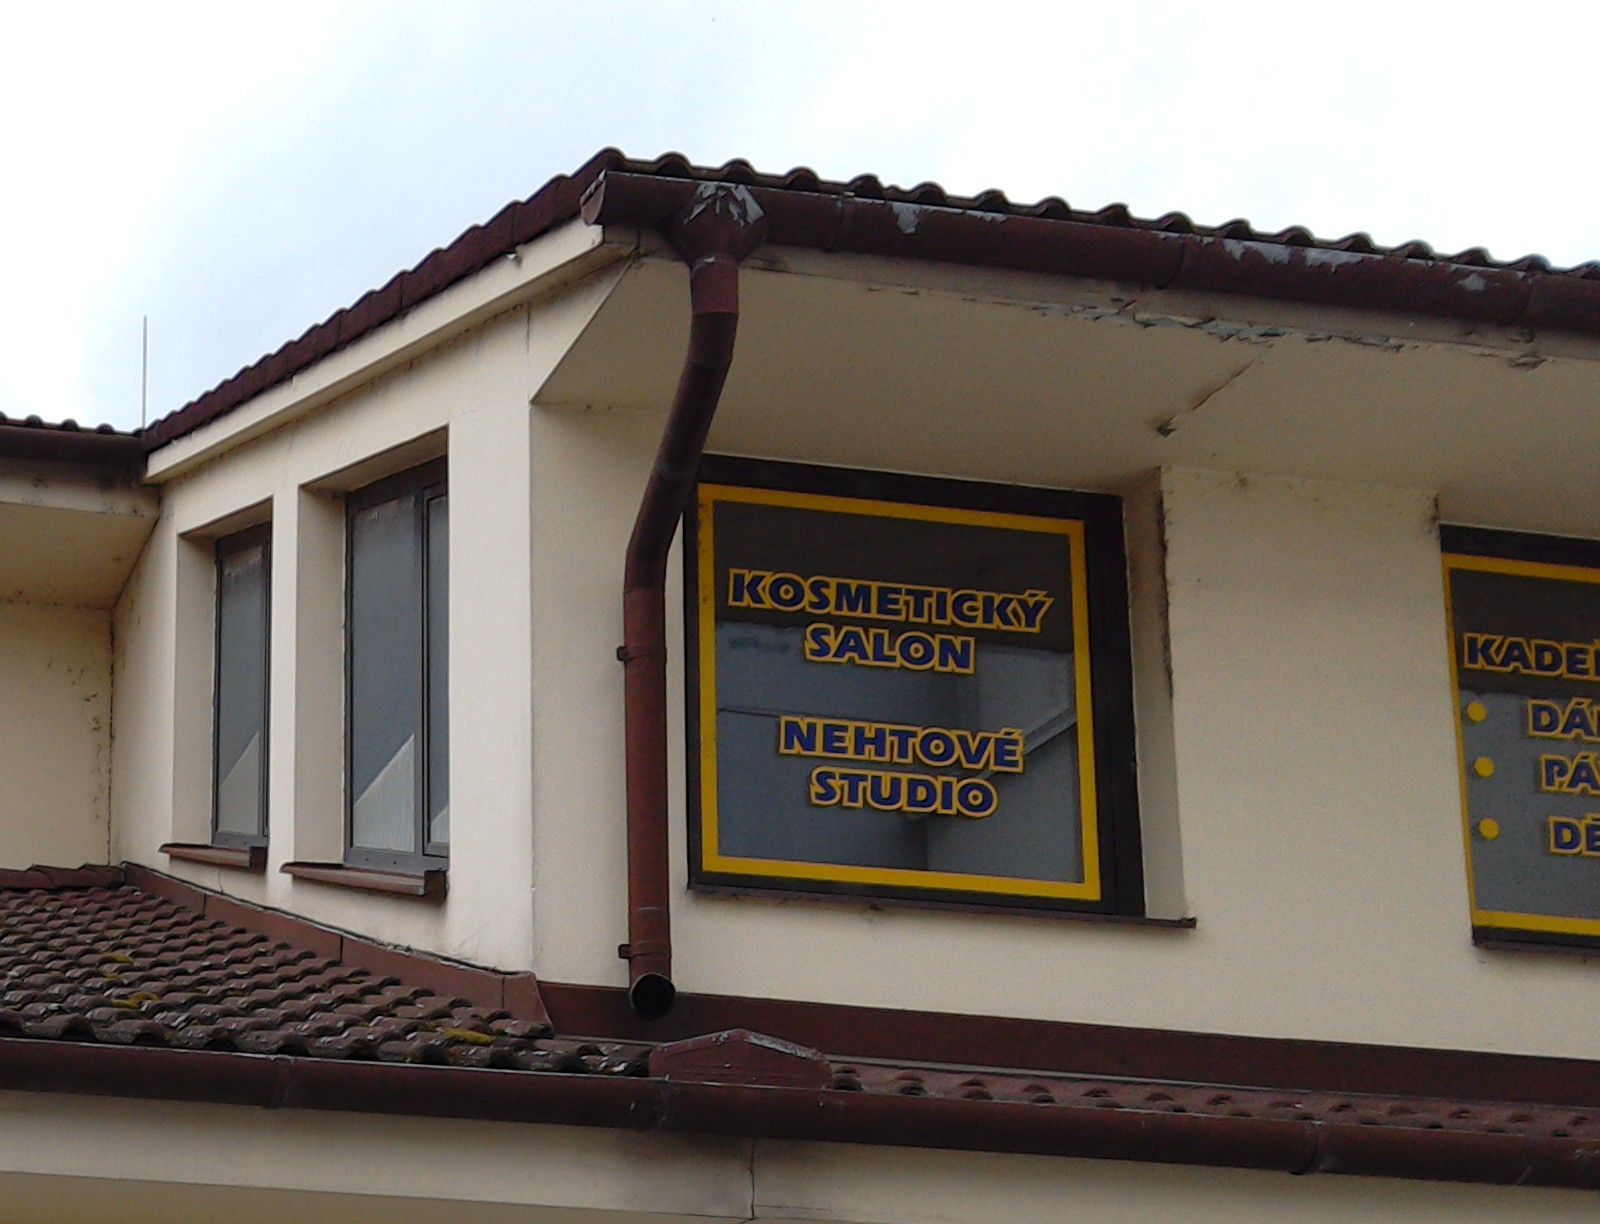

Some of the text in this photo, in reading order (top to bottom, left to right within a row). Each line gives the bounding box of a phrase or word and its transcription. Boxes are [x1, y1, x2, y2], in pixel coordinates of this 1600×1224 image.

[729, 567, 1055, 633] KOSMETICKÝ
[804, 623, 976, 675] SALON
[1463, 632, 1600, 682] KADE
[778, 716, 1024, 774] NEHTOVÉ
[1528, 696, 1600, 743] DÁ
[808, 766, 998, 818] STUDIO
